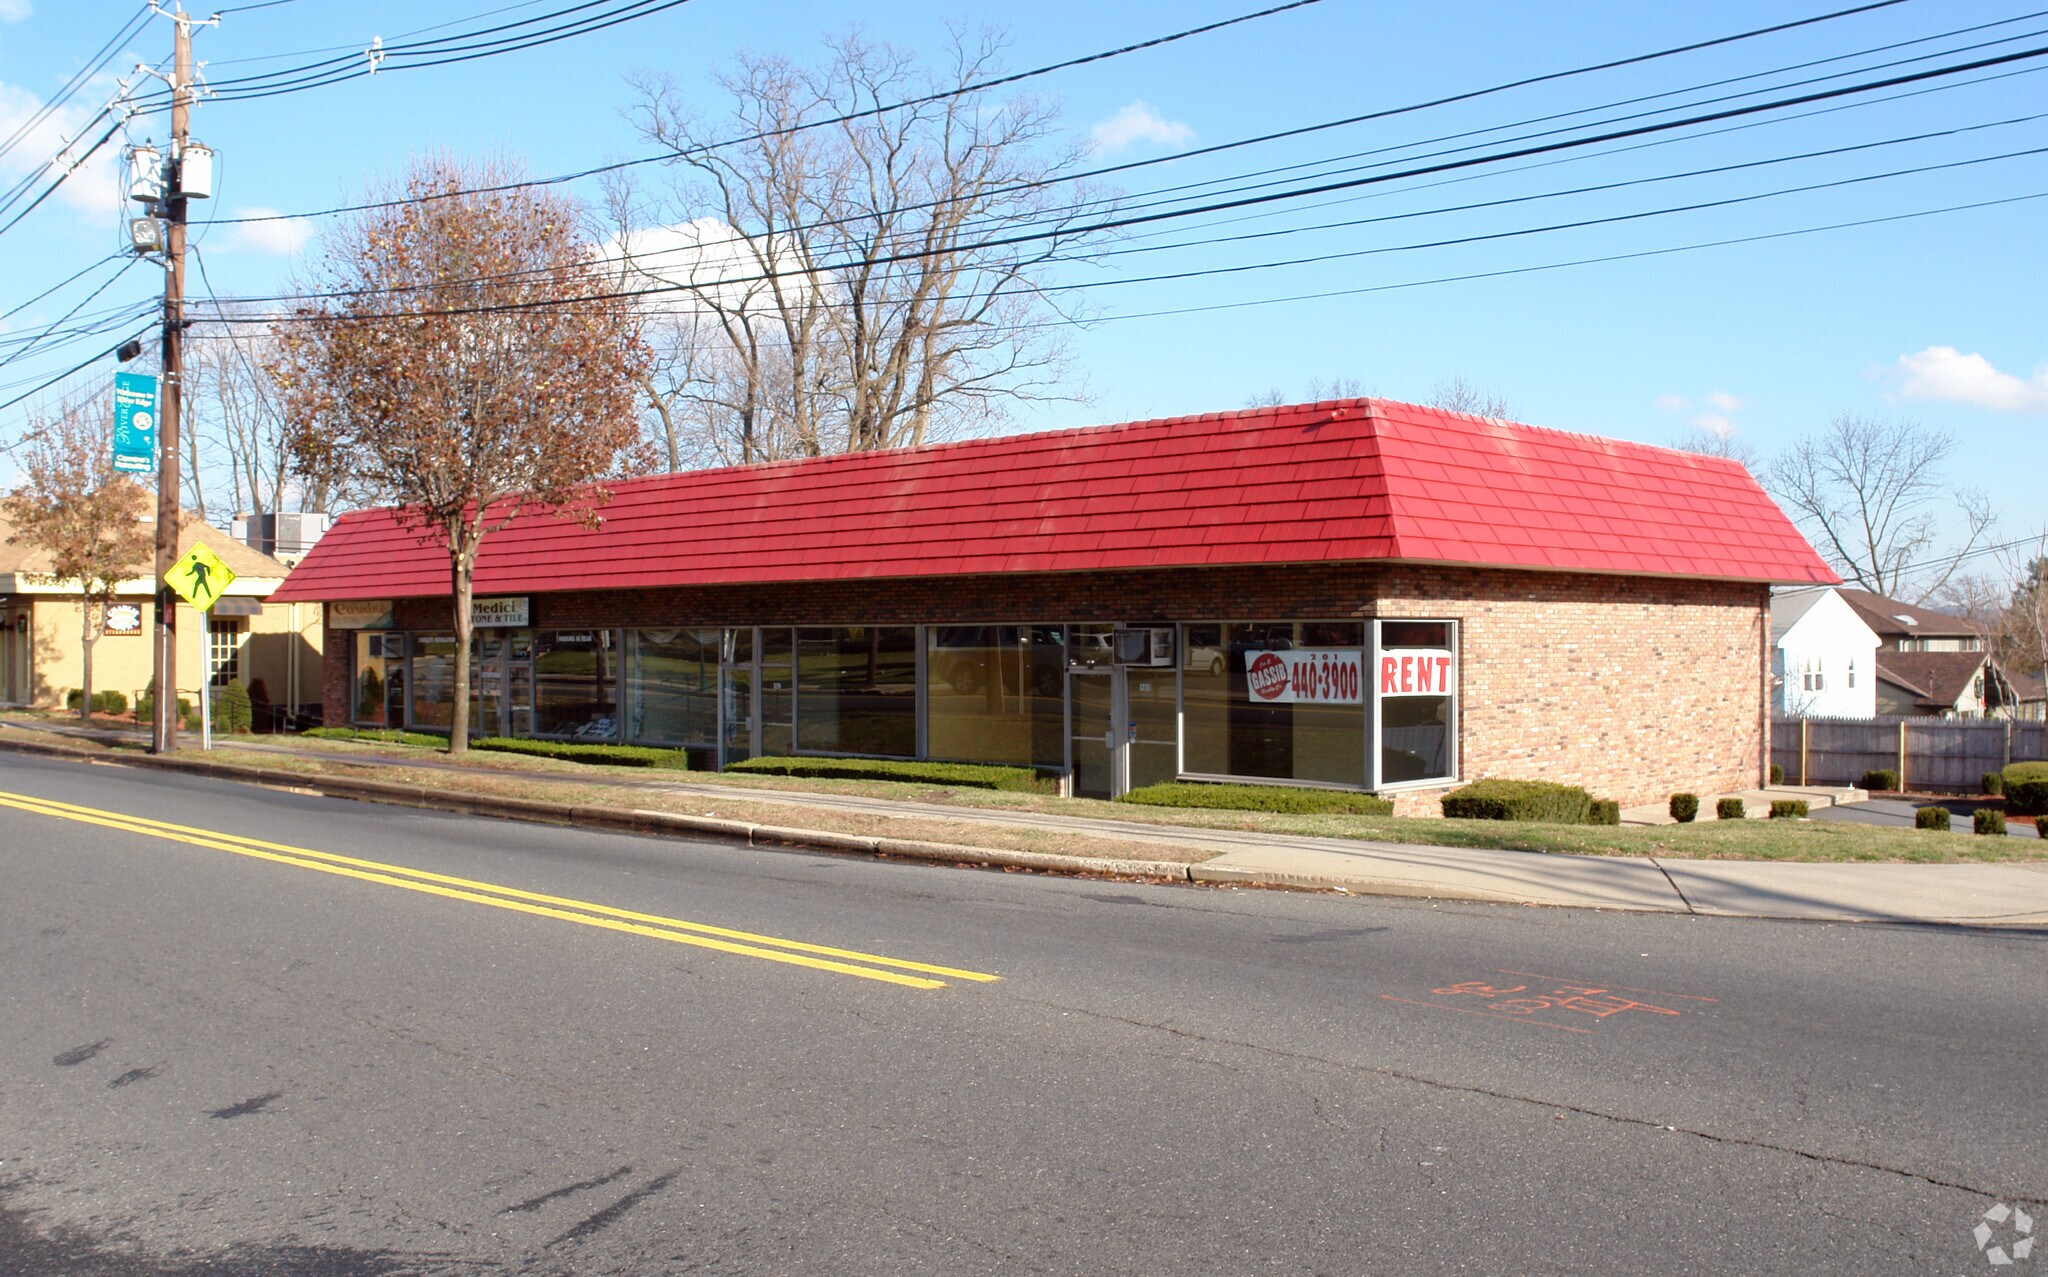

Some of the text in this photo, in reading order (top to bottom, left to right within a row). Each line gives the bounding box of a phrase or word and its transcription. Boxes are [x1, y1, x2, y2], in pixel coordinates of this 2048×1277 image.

[472, 600, 515, 614] Medici
[494, 614, 502, 623] &
[504, 613, 523, 623] TILE
[1251, 664, 1287, 690] GASSIB
[1381, 656, 1450, 693] RENT
